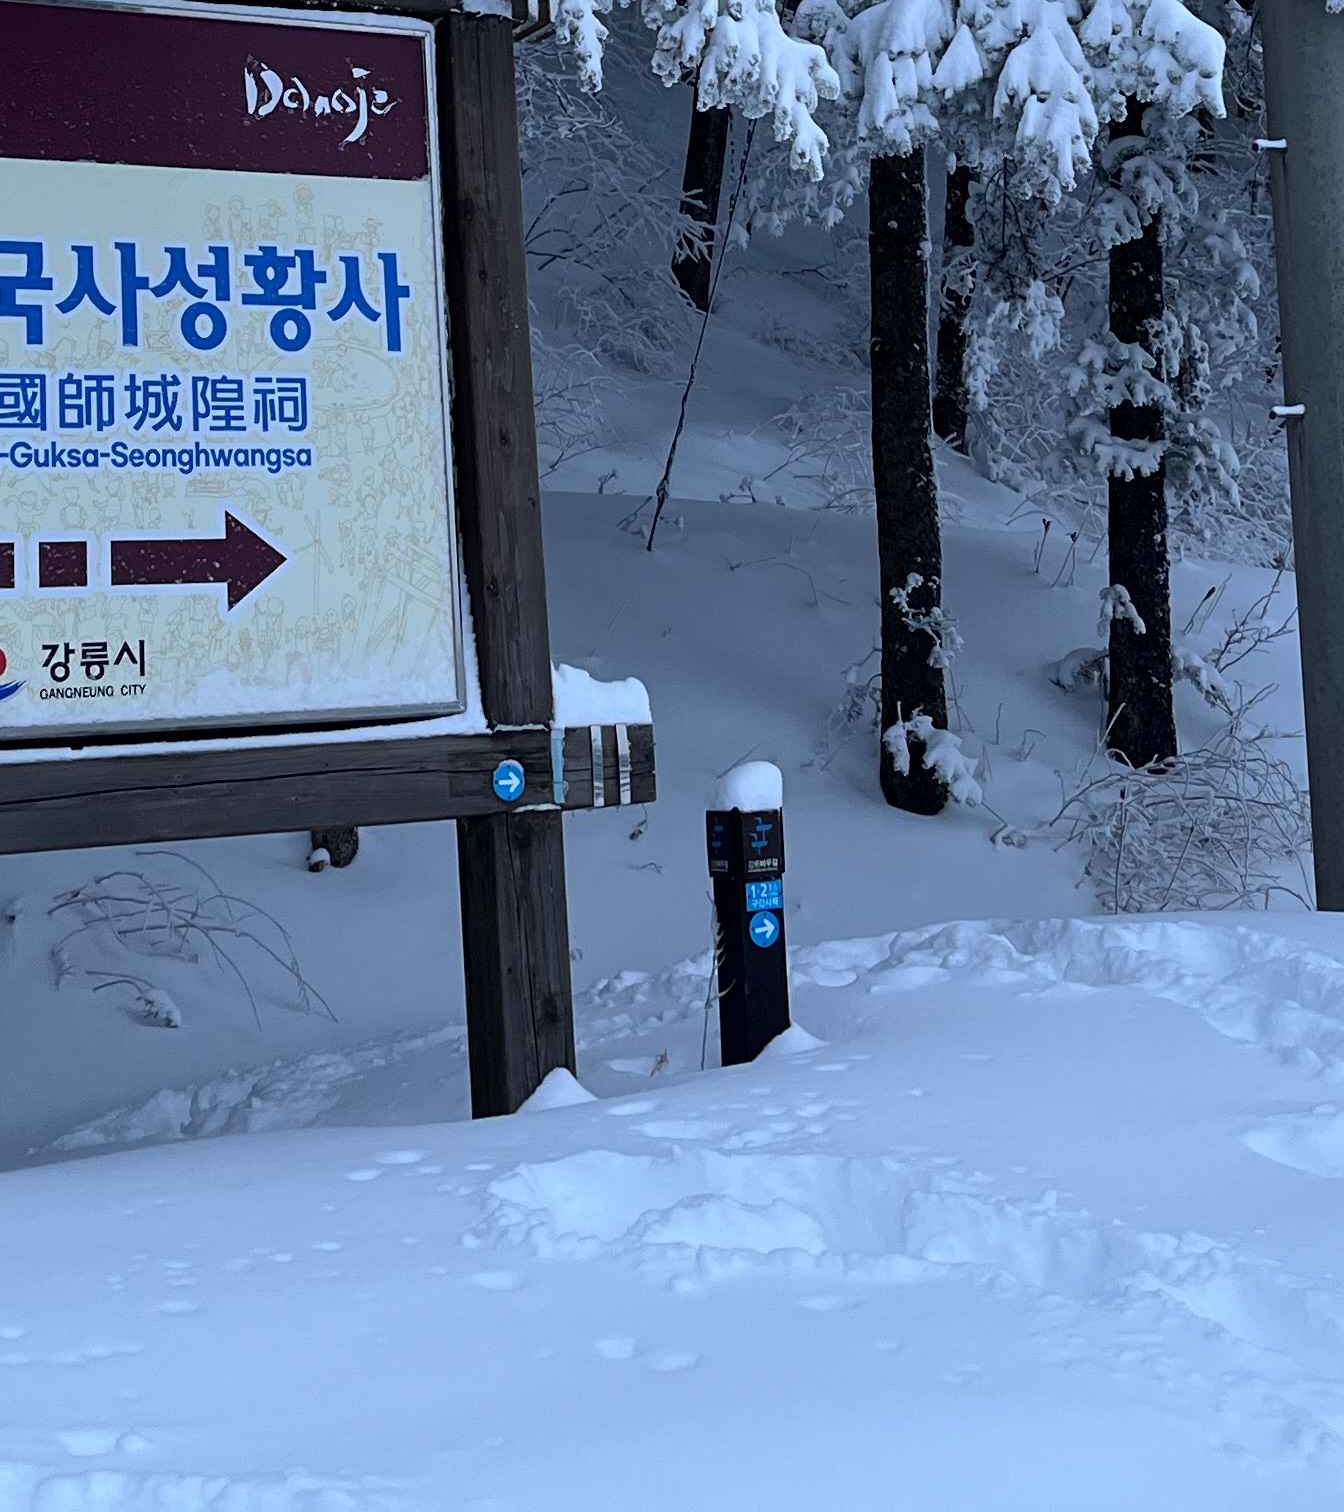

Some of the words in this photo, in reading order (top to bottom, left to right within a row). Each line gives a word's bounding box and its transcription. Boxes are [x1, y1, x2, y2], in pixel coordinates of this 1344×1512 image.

[40, 639, 146, 683] 강릉시
[39, 686, 114, 700] GANGNEUNG
[120, 684, 146, 696] CITY
